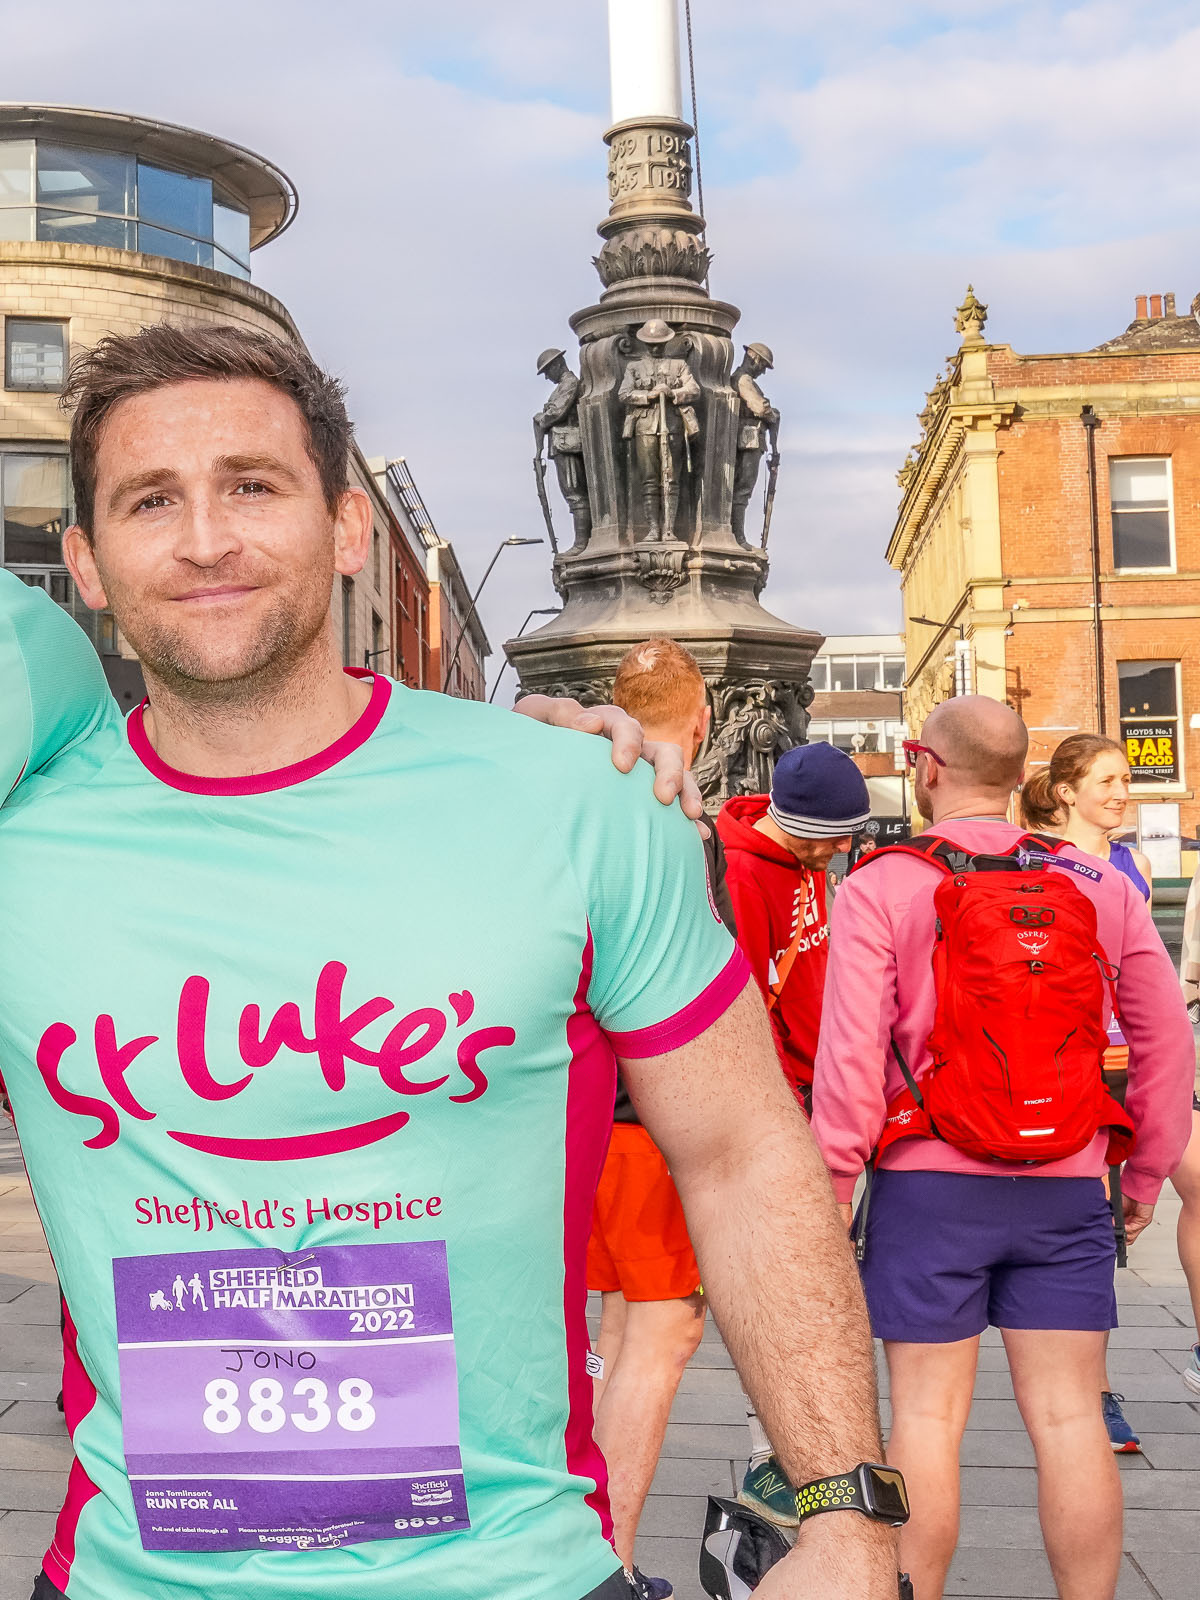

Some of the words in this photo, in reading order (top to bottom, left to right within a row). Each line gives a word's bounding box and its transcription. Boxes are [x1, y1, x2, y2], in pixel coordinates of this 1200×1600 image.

[1126, 738, 1173, 757] BAR
[1128, 757, 1136, 766] &
[1140, 755, 1174, 766] FOOD
[1073, 863, 1098, 879] 8078
[1017, 931, 1049, 940] OSPREY
[36, 1013, 159, 1150] St
[177, 960, 516, 1104] Luke's
[135, 1196, 296, 1232] Sheffield's
[307, 1192, 442, 1230] Hospice
[212, 1269, 319, 1288] SHEFFIELD
[214, 1288, 274, 1308] HALF
[276, 1286, 410, 1308] MARATHON
[349, 1309, 415, 1333] 2022
[220, 1349, 316, 1372] JONO
[202, 1377, 376, 1434] 8838
[412, 1480, 449, 1490] Sheffield
[146, 1498, 177, 1509] RUN
[180, 1498, 209, 1510] FOR
[212, 1499, 238, 1510] ALL
[259, 1534, 314, 1544] Baggage
[317, 1530, 349, 1543] label
